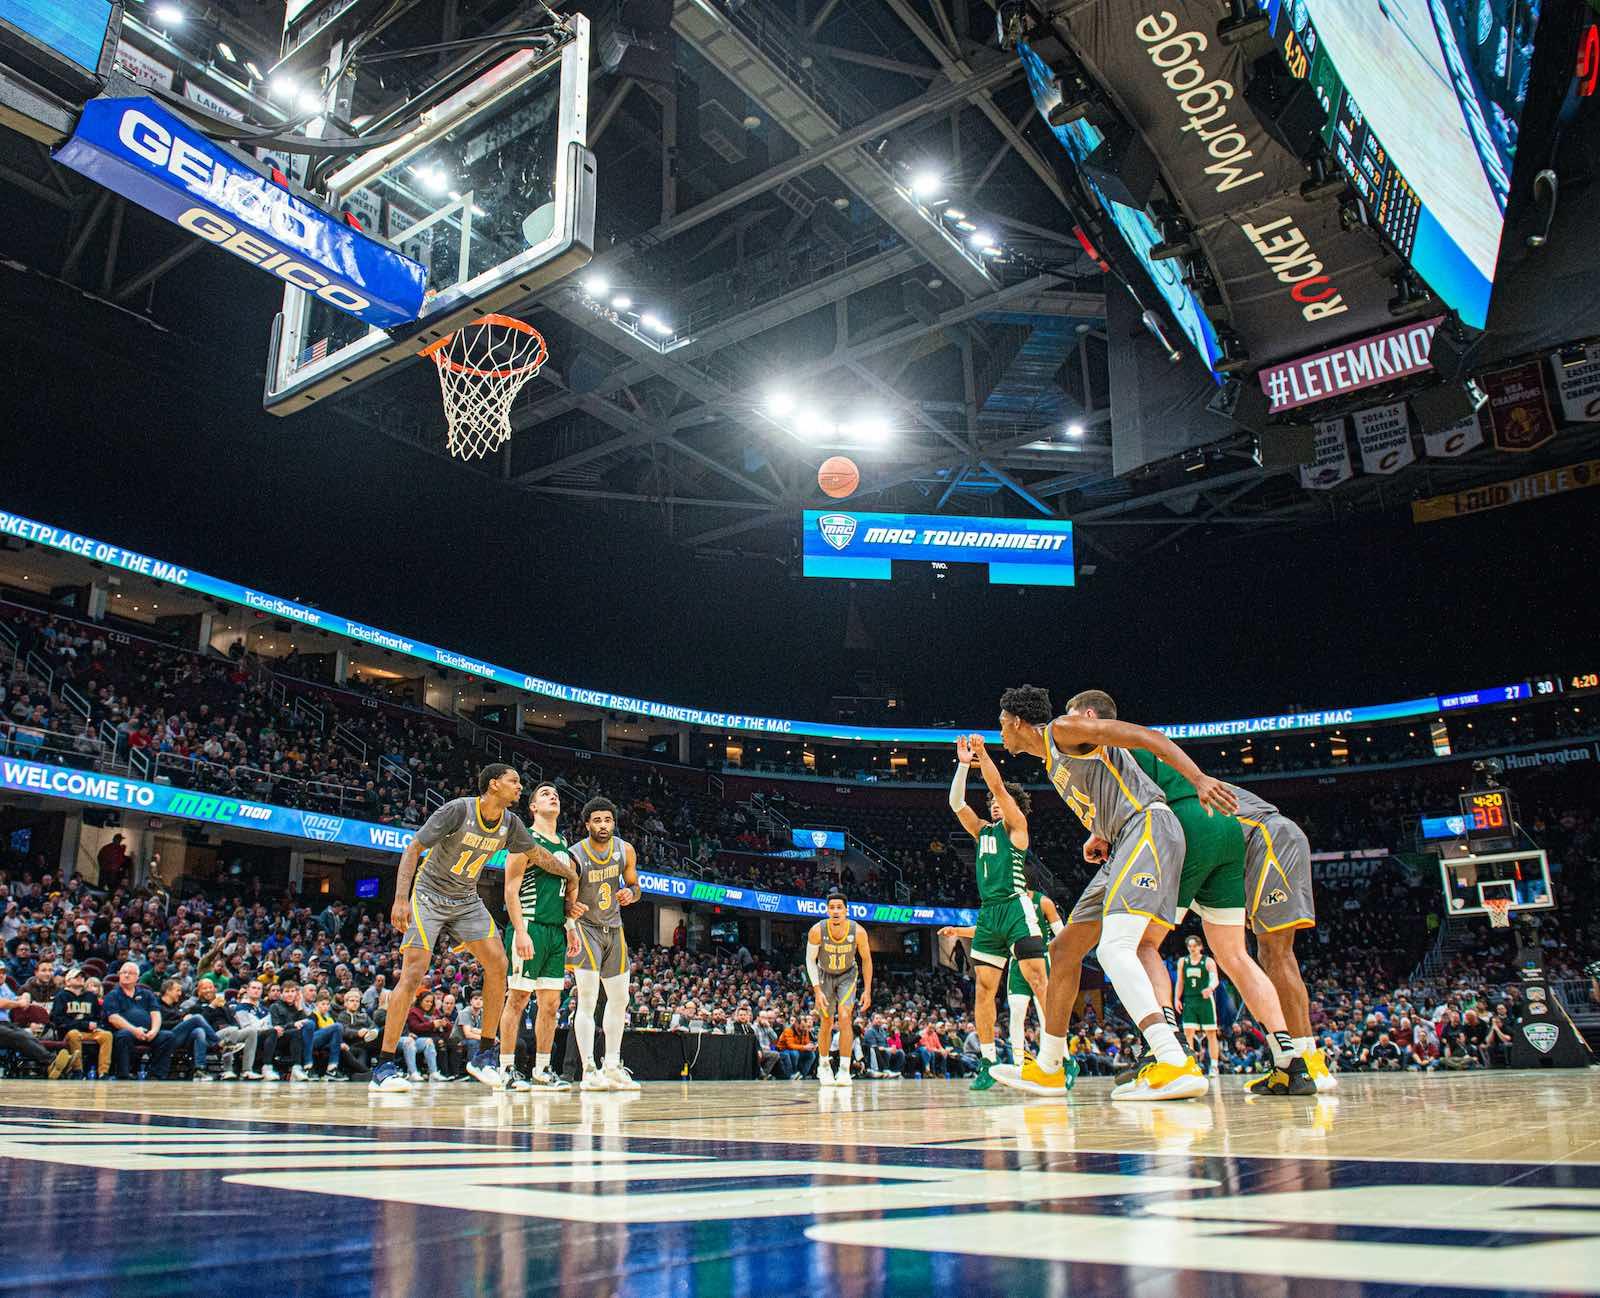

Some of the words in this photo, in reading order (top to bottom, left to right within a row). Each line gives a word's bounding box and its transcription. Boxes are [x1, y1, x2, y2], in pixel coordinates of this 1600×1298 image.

[196, 94, 231, 117] LARRY
[1136, 11, 1264, 192] Mortgage
[118, 109, 316, 250] GEICO
[178, 207, 371, 314] GEICO
[1241, 216, 1349, 322] ROCKET
[1268, 325, 1436, 408] #LETEMKNO
[1360, 426, 1408, 445] CONFERENCE
[1365, 419, 1399, 434] EASTERN
[1363, 436, 1407, 453] CHAMPIONS
[864, 527, 917, 545] MAC
[923, 531, 1068, 551] TOURNAMENT
[95, 544, 118, 562] OF
[121, 551, 150, 574] THE
[152, 561, 188, 584] MAC
[244, 591, 320, 624] TicketSmarter
[346, 622, 414, 652] TicketSmarter
[435, 649, 496, 678] TicketSmarter
[1537, 681, 1554, 695] 30
[1571, 673, 1599, 689] 4:20
[524, 676, 568, 700] OFFICIAL
[570, 687, 609, 708] TICKET
[609, 695, 650, 715] RESALE
[650, 702, 725, 727] MARKETPLACE
[726, 714, 743, 728] OF
[744, 716, 765, 731] THE
[767, 719, 792, 733] MAC
[1504, 686, 1520, 700] 27
[1189, 717, 1276, 737] MARKETPLACE
[1278, 716, 1295, 730] OF
[1298, 713, 1321, 727] THE
[1323, 710, 1352, 724] MAC
[3, 761, 121, 801] WELCOME
[124, 783, 154, 806] TO
[1473, 793, 1503, 808] 4:20
[1472, 806, 1503, 829] 30
[369, 827, 414, 850] WELC
[450, 850, 488, 879] 14
[983, 861, 989, 878] 1
[638, 874, 670, 893] COME
[671, 879, 686, 895] TO
[1139, 877, 1151, 888] K
[598, 881, 612, 911] 3
[851, 905, 867, 917] TO
[828, 954, 846, 970] 11
